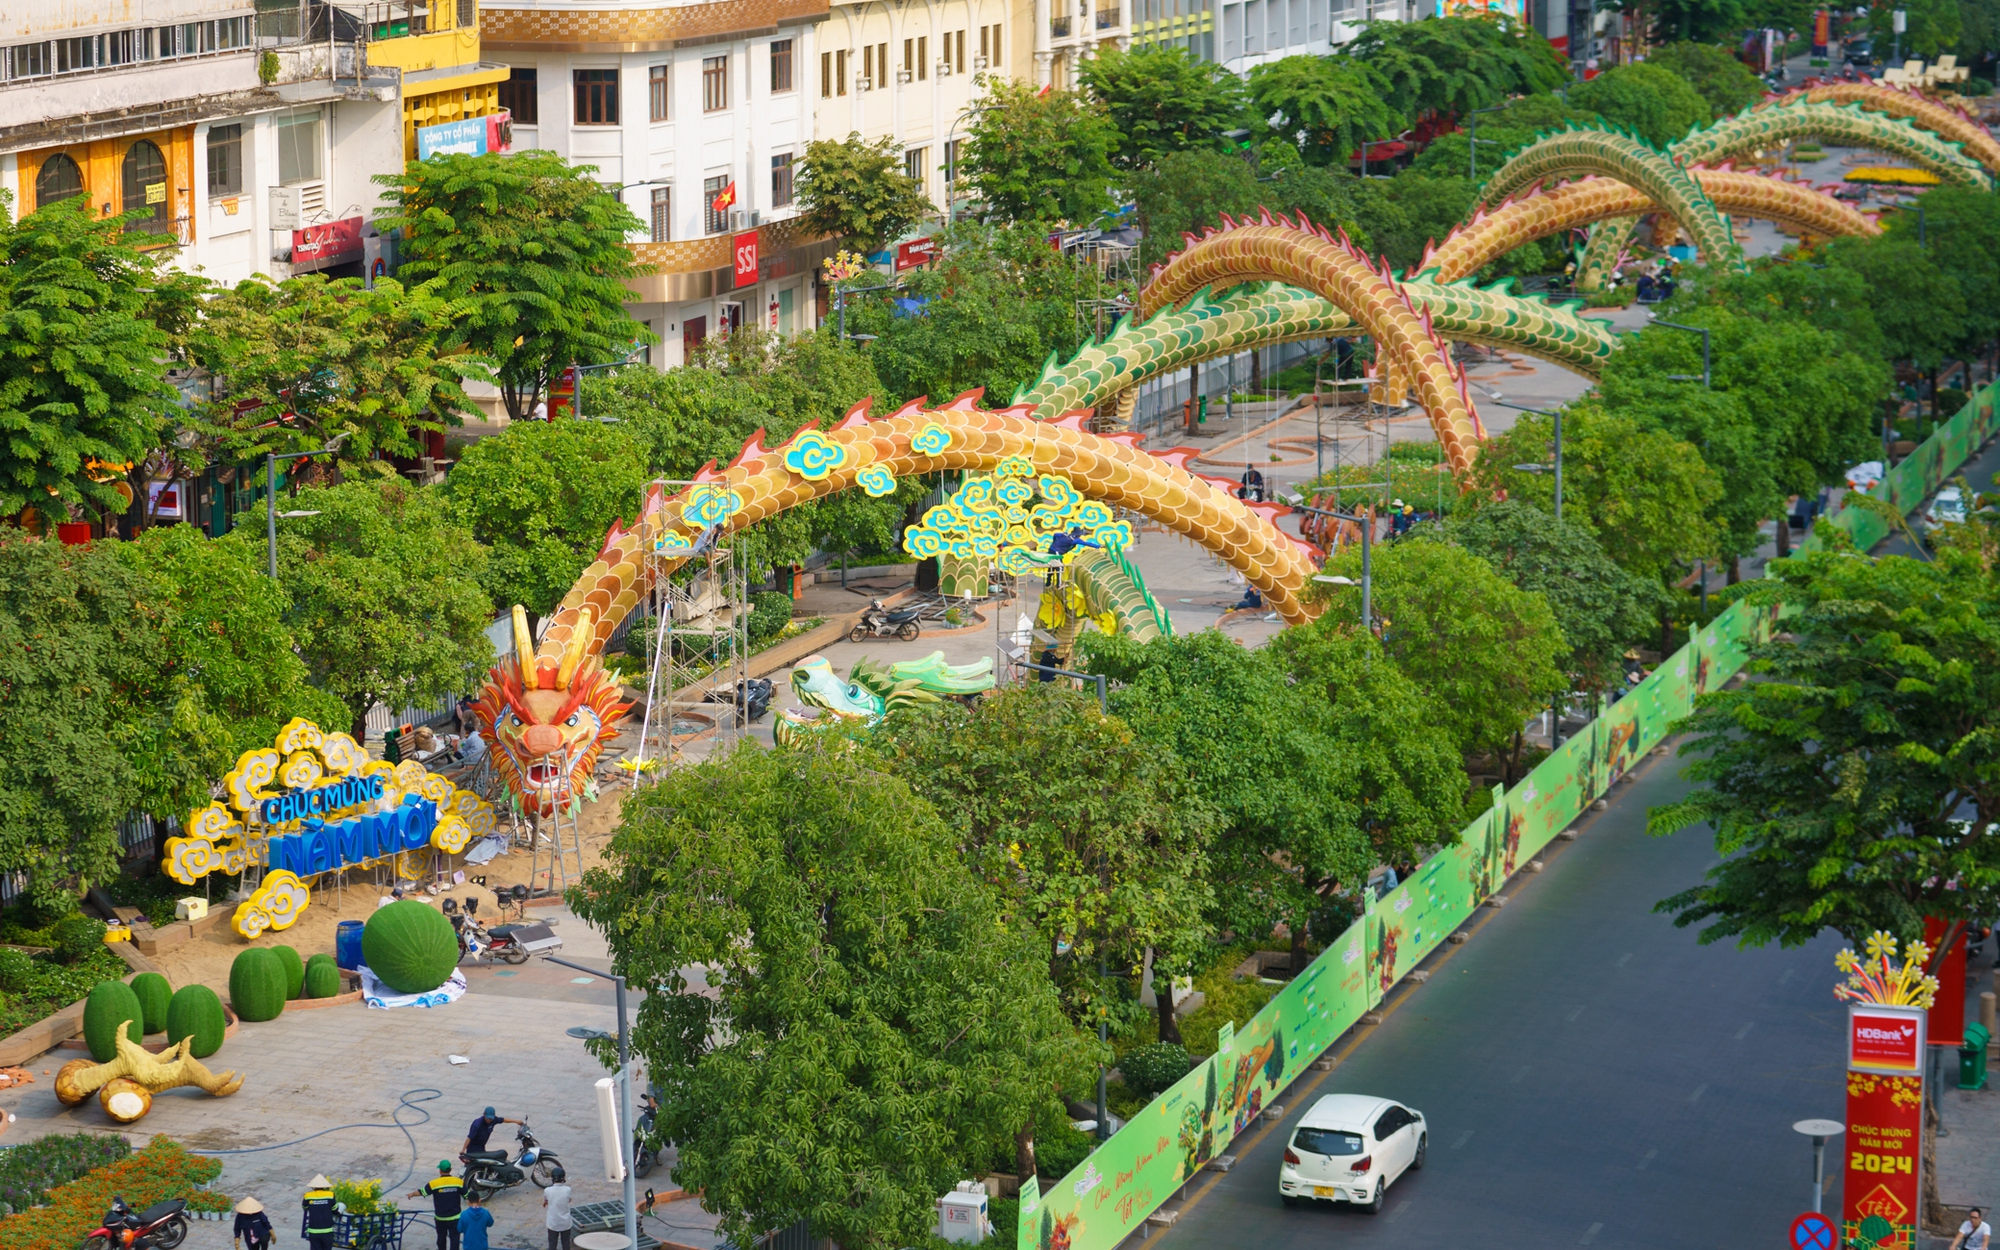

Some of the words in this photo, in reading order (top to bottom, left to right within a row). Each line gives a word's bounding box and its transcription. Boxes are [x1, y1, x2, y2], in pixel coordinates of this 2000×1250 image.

[425, 130, 442, 143] CÔNG
[443, 130, 451, 140] TY
[737, 244, 756, 274] SSI
[262, 786, 322, 824] CHÚC
[324, 775, 384, 813] MỪNG
[269, 817, 363, 878] NĂM
[361, 793, 437, 859] MỚI
[1857, 1027, 1902, 1041] HDBank
[1851, 1124, 1878, 1135] CHÚC
[1881, 1126, 1912, 1138] MỪNG
[1859, 1137, 1881, 1148] NĂM
[1883, 1137, 1902, 1149] MỚI
[1850, 1151, 1912, 1174] 2024
